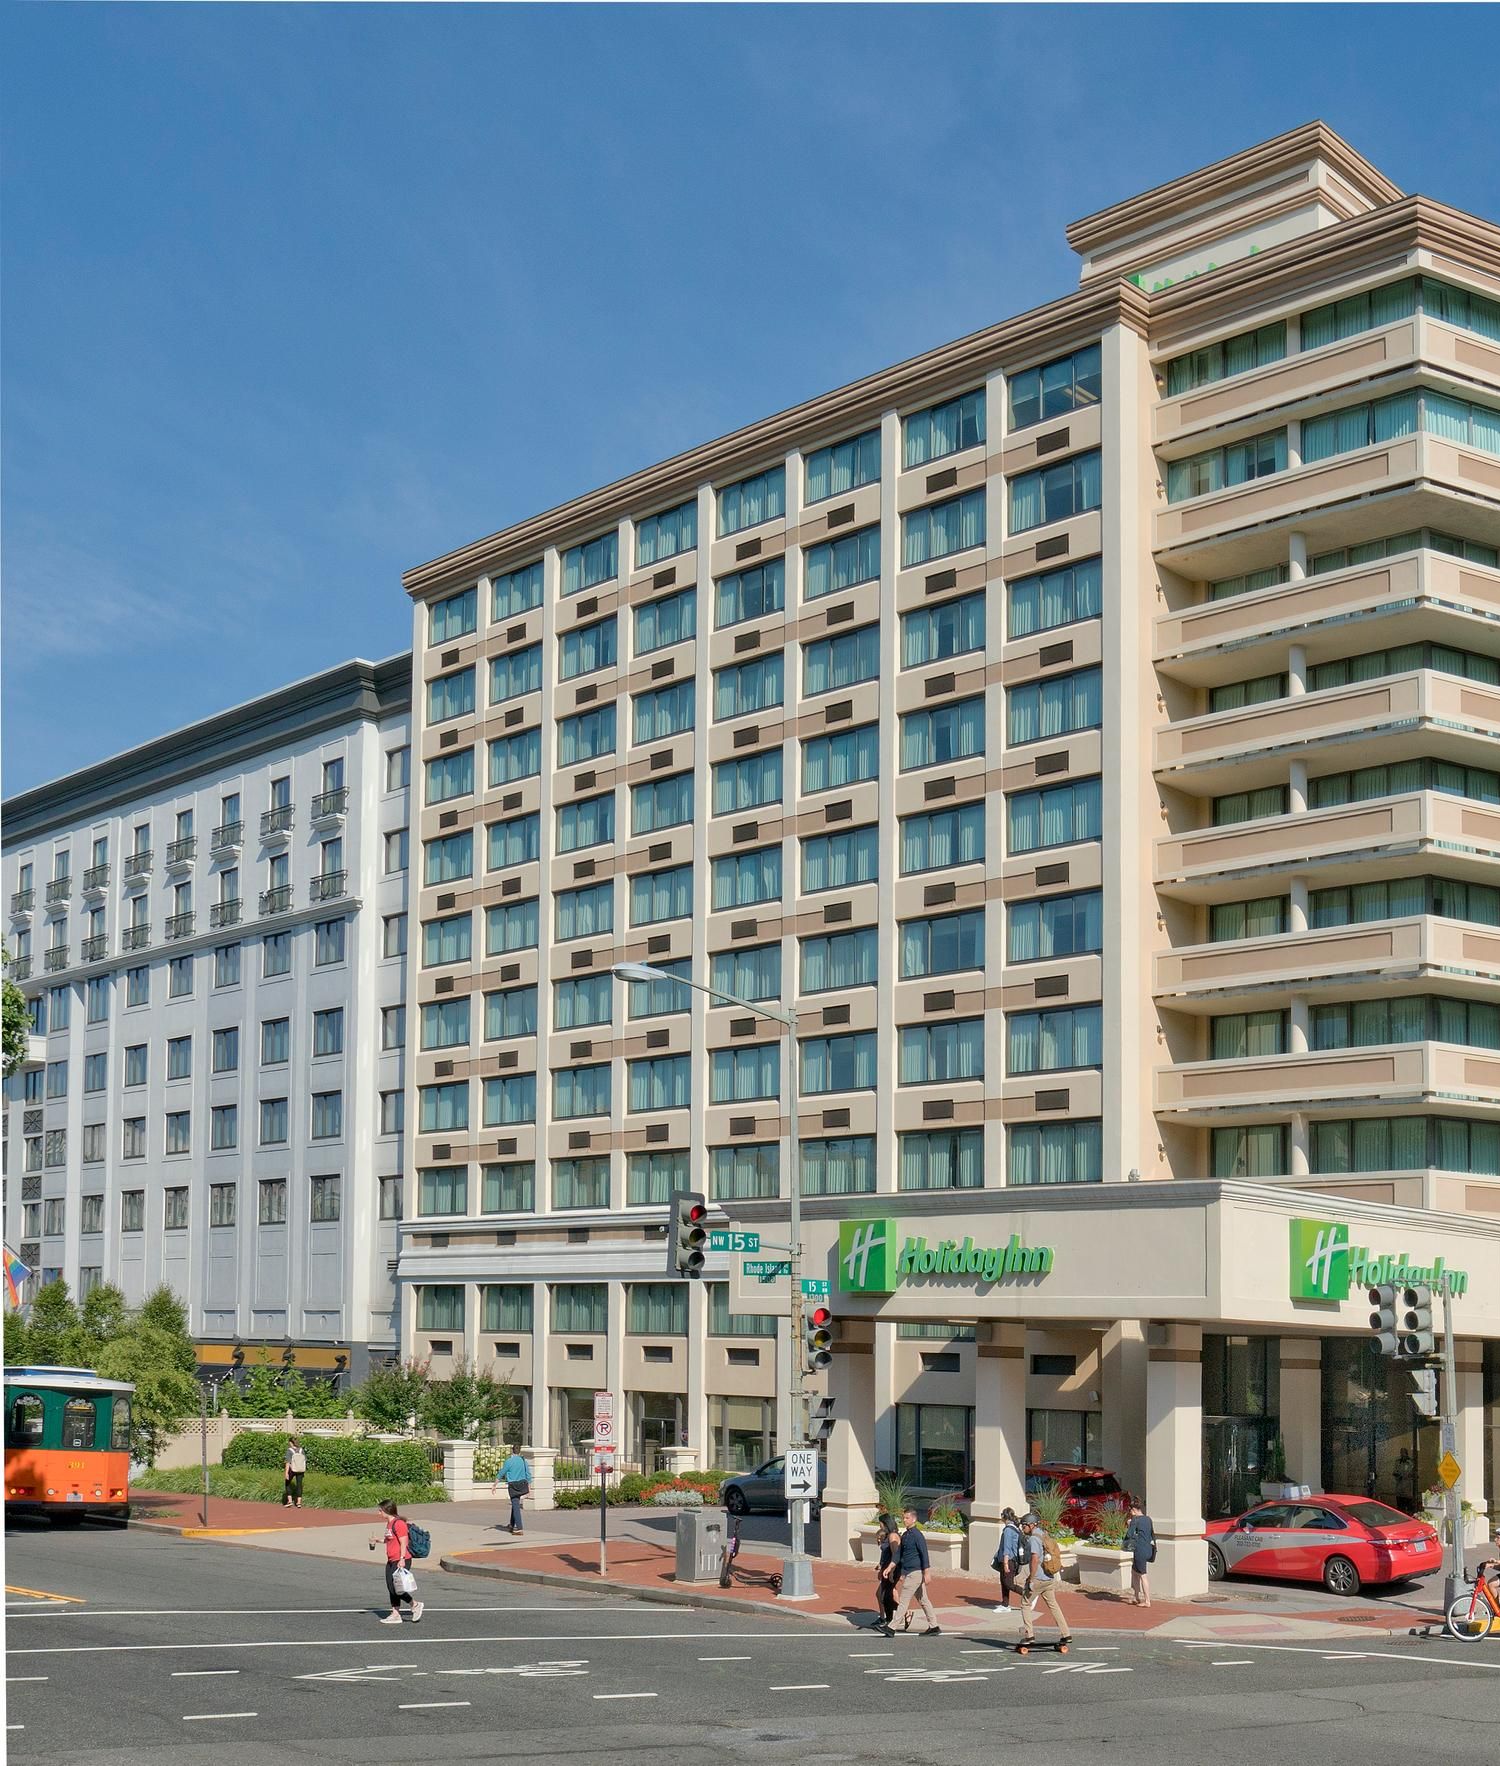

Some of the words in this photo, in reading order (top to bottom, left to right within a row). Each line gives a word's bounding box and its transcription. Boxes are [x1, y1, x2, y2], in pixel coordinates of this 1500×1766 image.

[712, 1235, 724, 1246] NW
[727, 1233, 746, 1250] 15
[748, 1237, 758, 1248] ST
[746, 1263, 763, 1274] Rhode
[808, 1281, 817, 1292] 15
[791, 1453, 813, 1465] ONE
[790, 1466, 813, 1478] WAY
